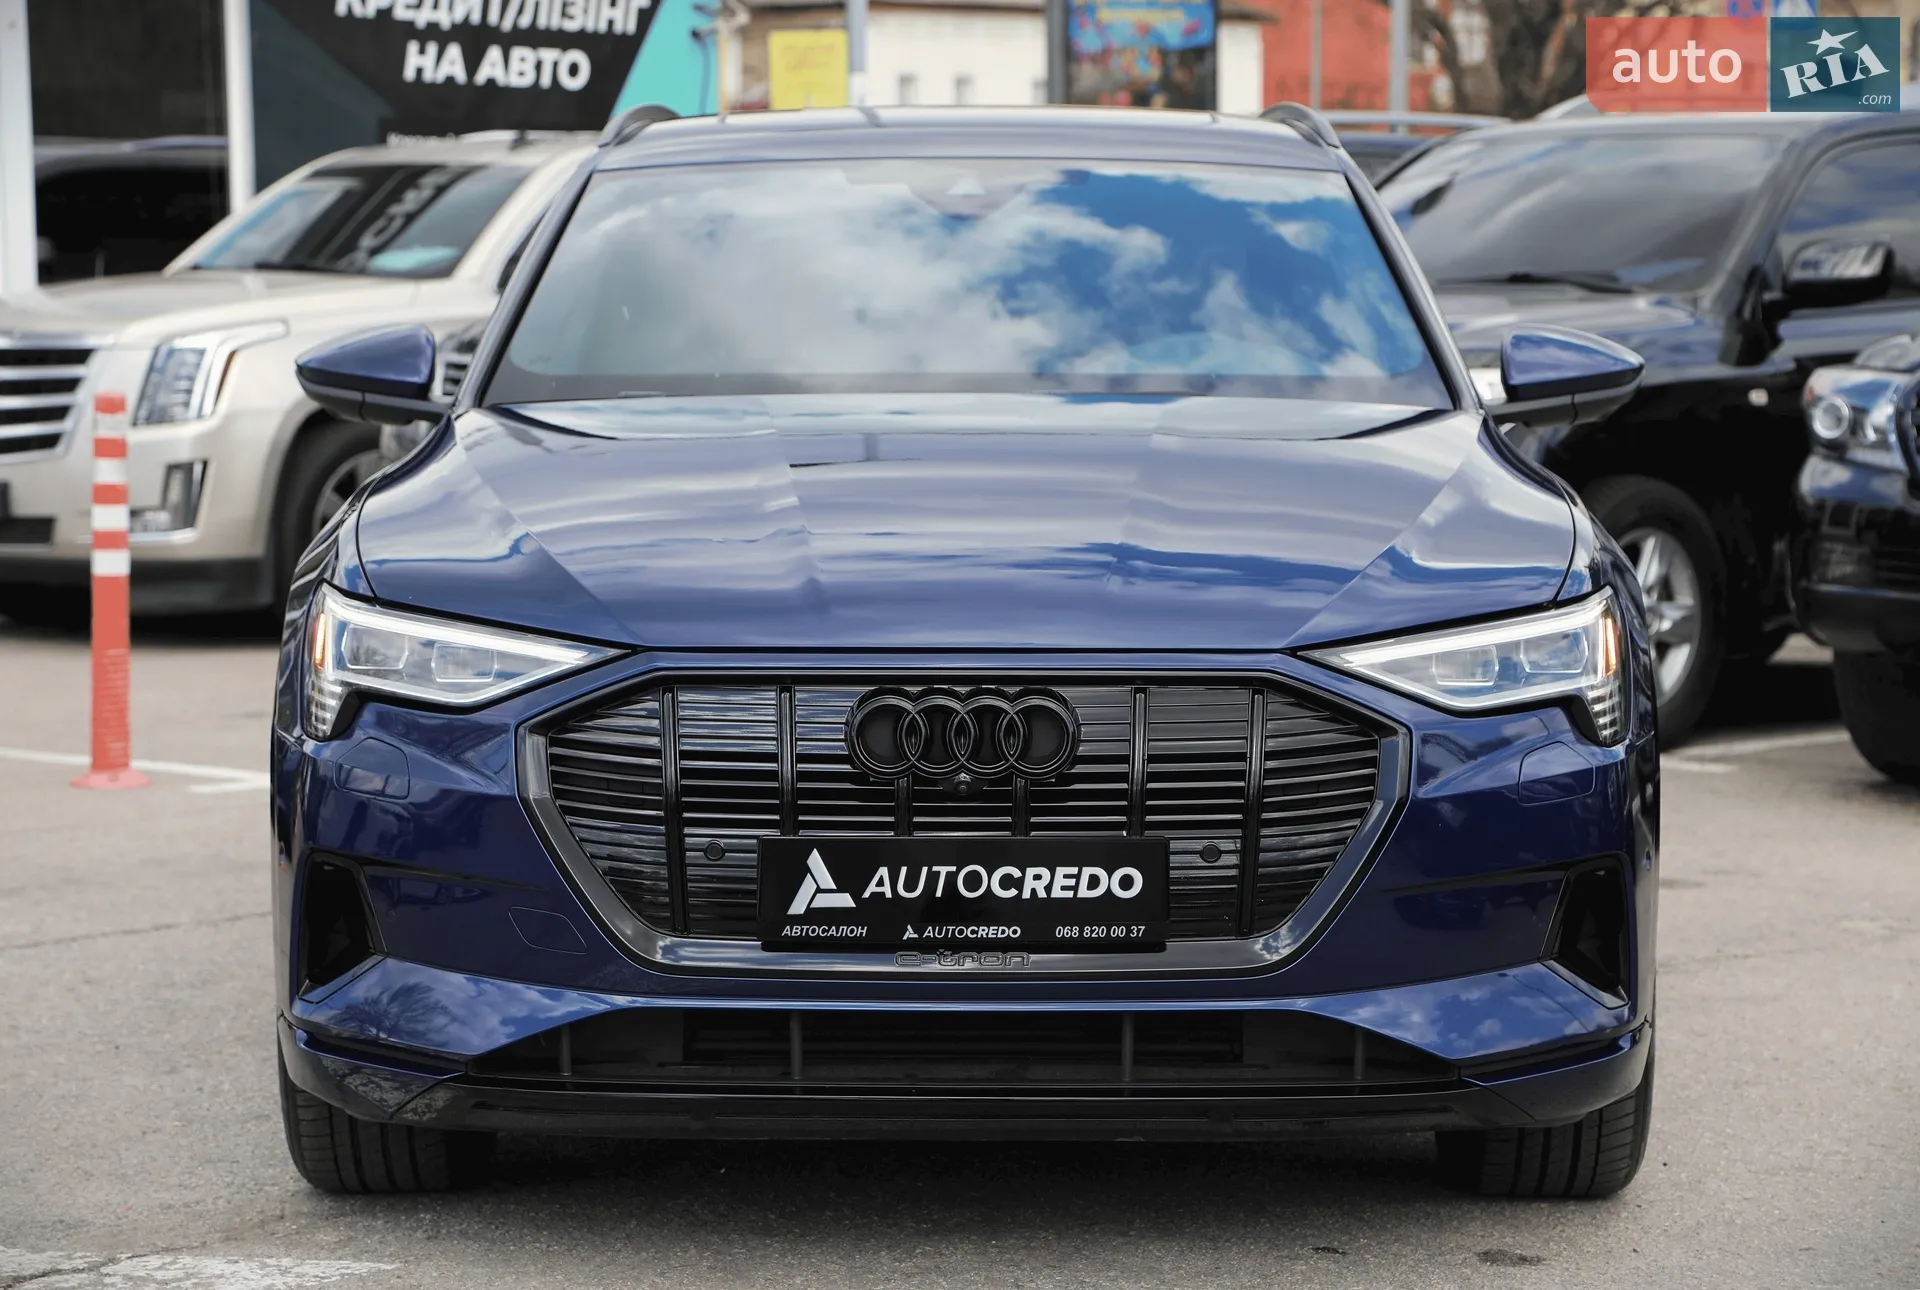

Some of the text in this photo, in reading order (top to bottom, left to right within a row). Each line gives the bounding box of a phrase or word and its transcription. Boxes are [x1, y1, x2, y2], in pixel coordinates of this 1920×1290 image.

[402, 39, 592, 92] НА АВТО
[861, 864, 1144, 900] AUTOCREDO
[781, 925, 868, 938] АВТОСАЛОН
[922, 925, 1022, 938] AUTOCREDO
[1055, 925, 1146, 938] 068 820 00 37
[894, 949, 1032, 967] e-tron
